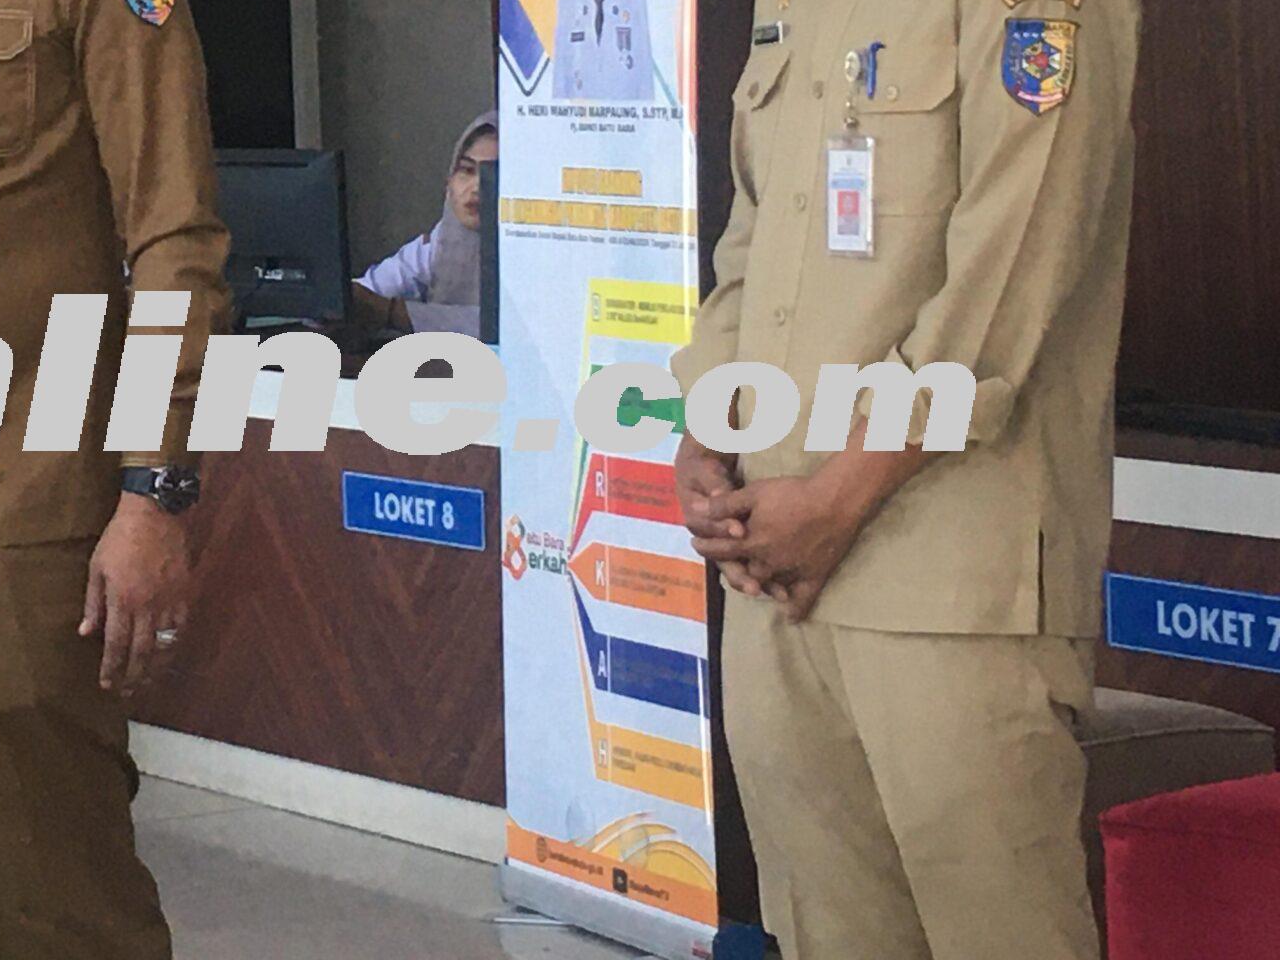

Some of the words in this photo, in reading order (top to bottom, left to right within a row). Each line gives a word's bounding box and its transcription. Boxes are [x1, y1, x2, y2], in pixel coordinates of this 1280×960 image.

[595, 471, 605, 497] R
[374, 491, 436, 527] LOKET
[442, 501, 455, 530] 8
[595, 559, 605, 586] K
[1156, 599, 1255, 648] LOKET
[1266, 615, 1280, 652] 7
[597, 650, 608, 678] A
